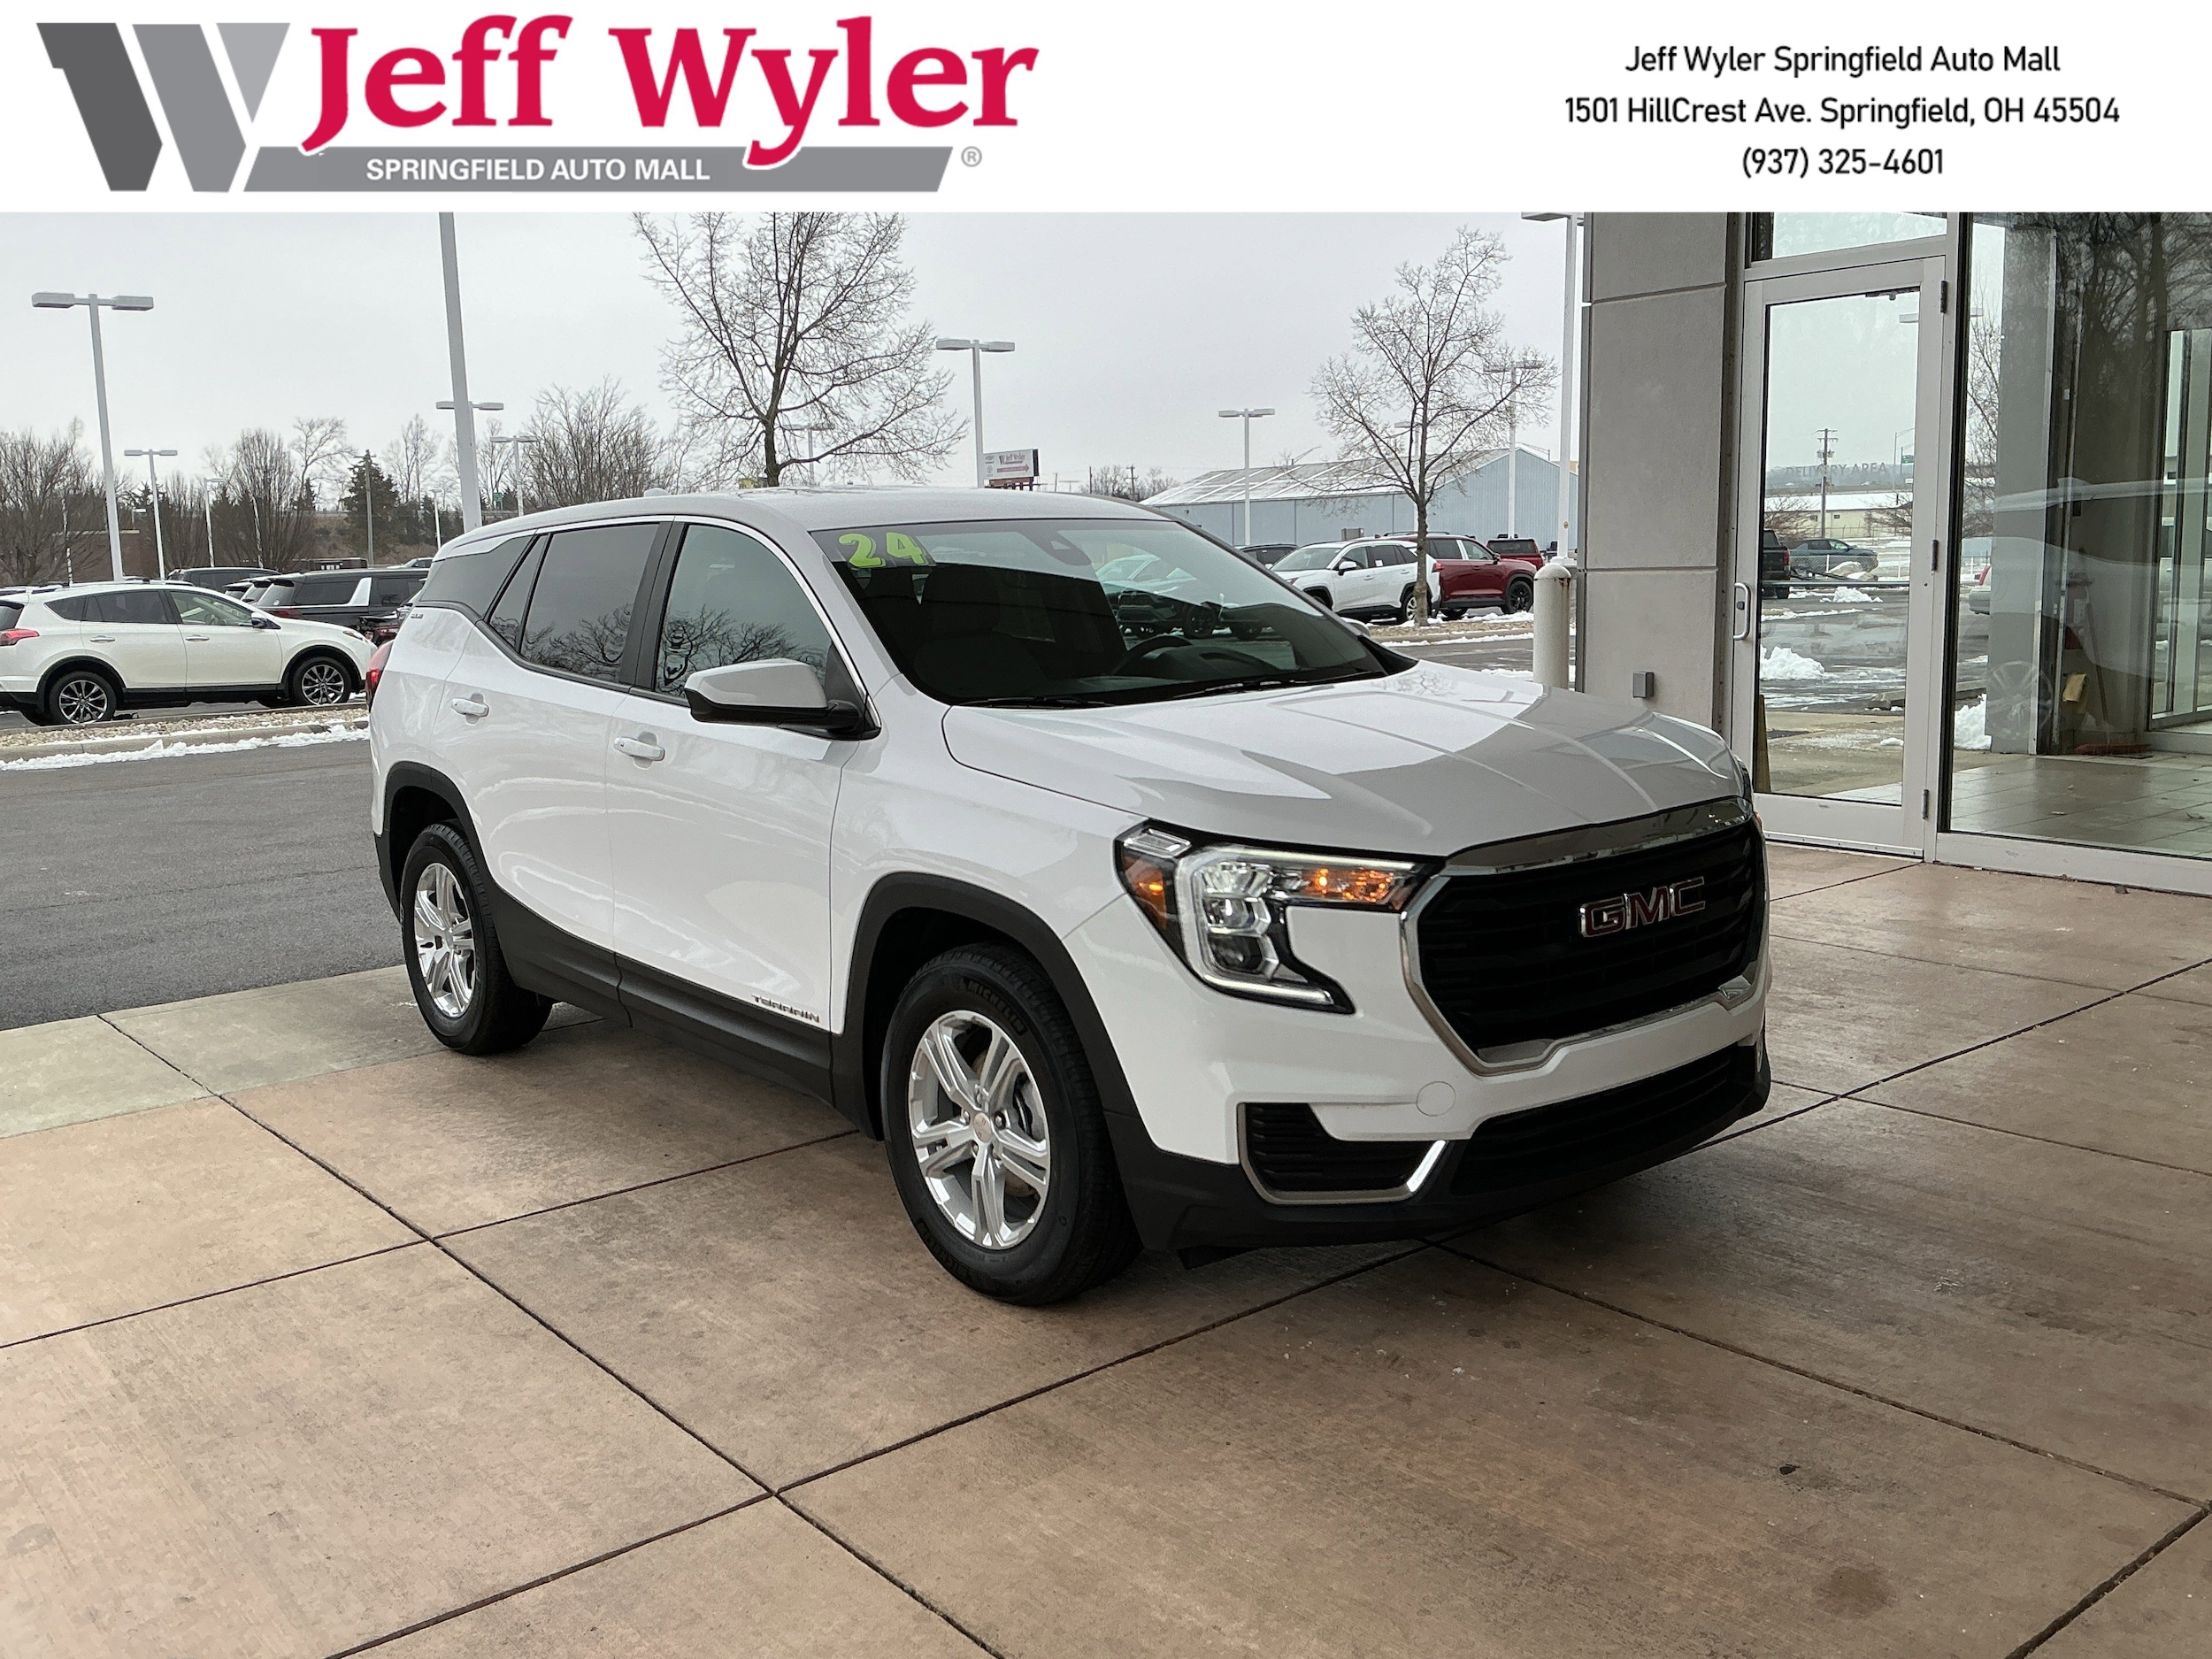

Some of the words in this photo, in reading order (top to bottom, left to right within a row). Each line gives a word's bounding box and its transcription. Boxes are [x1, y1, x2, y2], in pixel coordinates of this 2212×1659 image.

[1851, 462, 1887, 475] AREA
[839, 532, 927, 566] 24
[1578, 876, 1706, 938] GMC
[750, 994, 820, 1024] TERRAIN
[966, 978, 1025, 1034] MICHELIN
